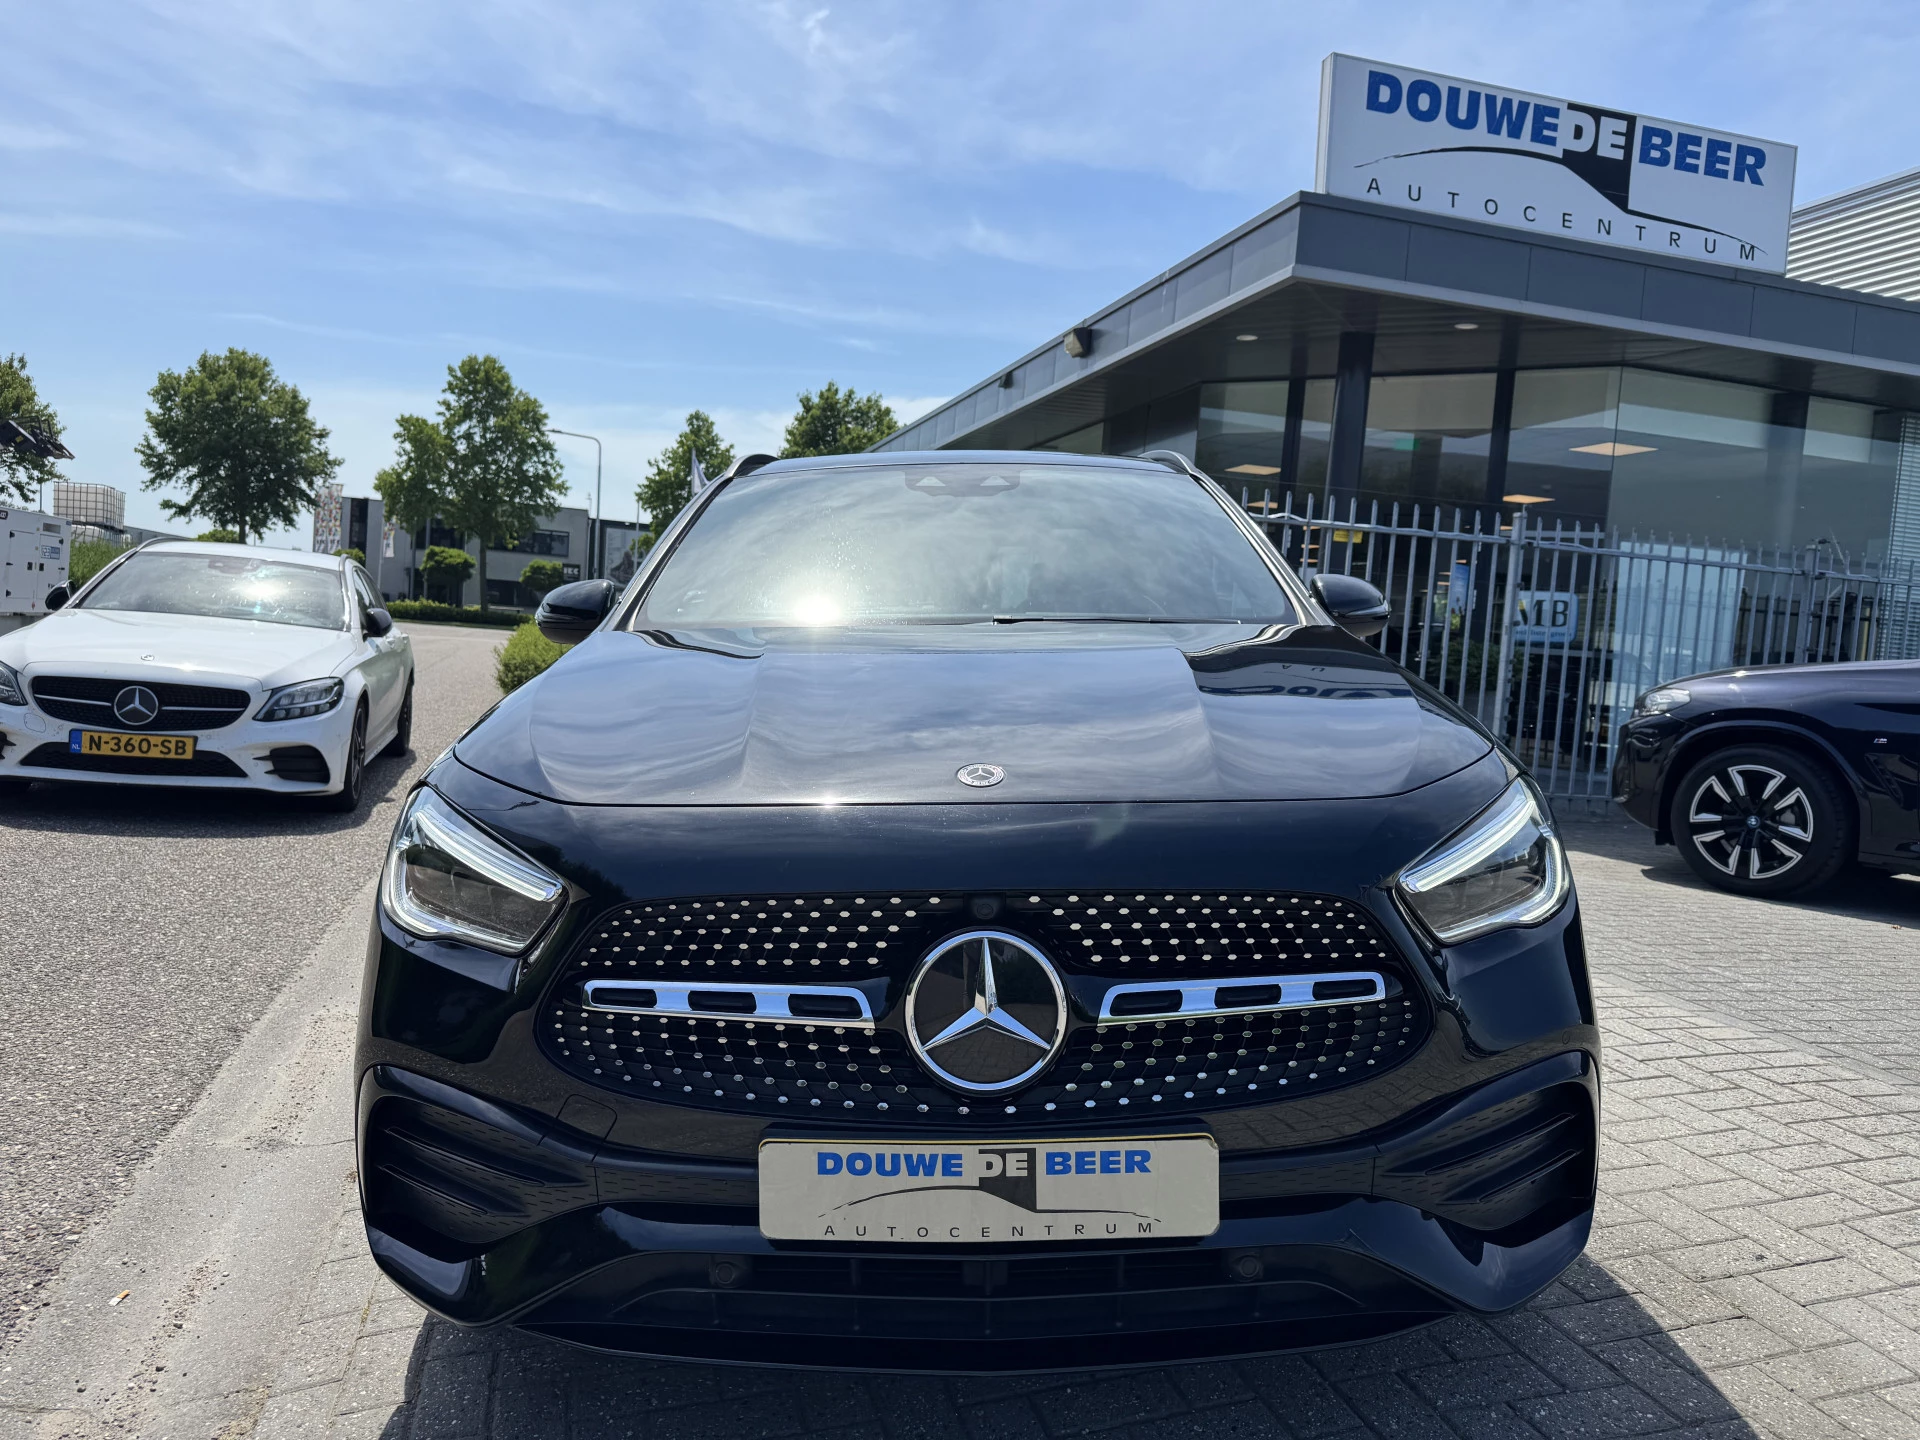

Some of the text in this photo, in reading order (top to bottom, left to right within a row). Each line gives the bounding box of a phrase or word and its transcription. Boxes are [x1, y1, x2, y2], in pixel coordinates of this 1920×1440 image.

[1365, 69, 1767, 187] DOUWE DE BEER
[1366, 177, 1756, 262] AUTOCENTRUM
[88, 734, 187, 756] N-360-SB
[817, 1150, 1152, 1177] DOUWE DE BEER
[824, 1222, 1152, 1238] AUTOCENTRUM
